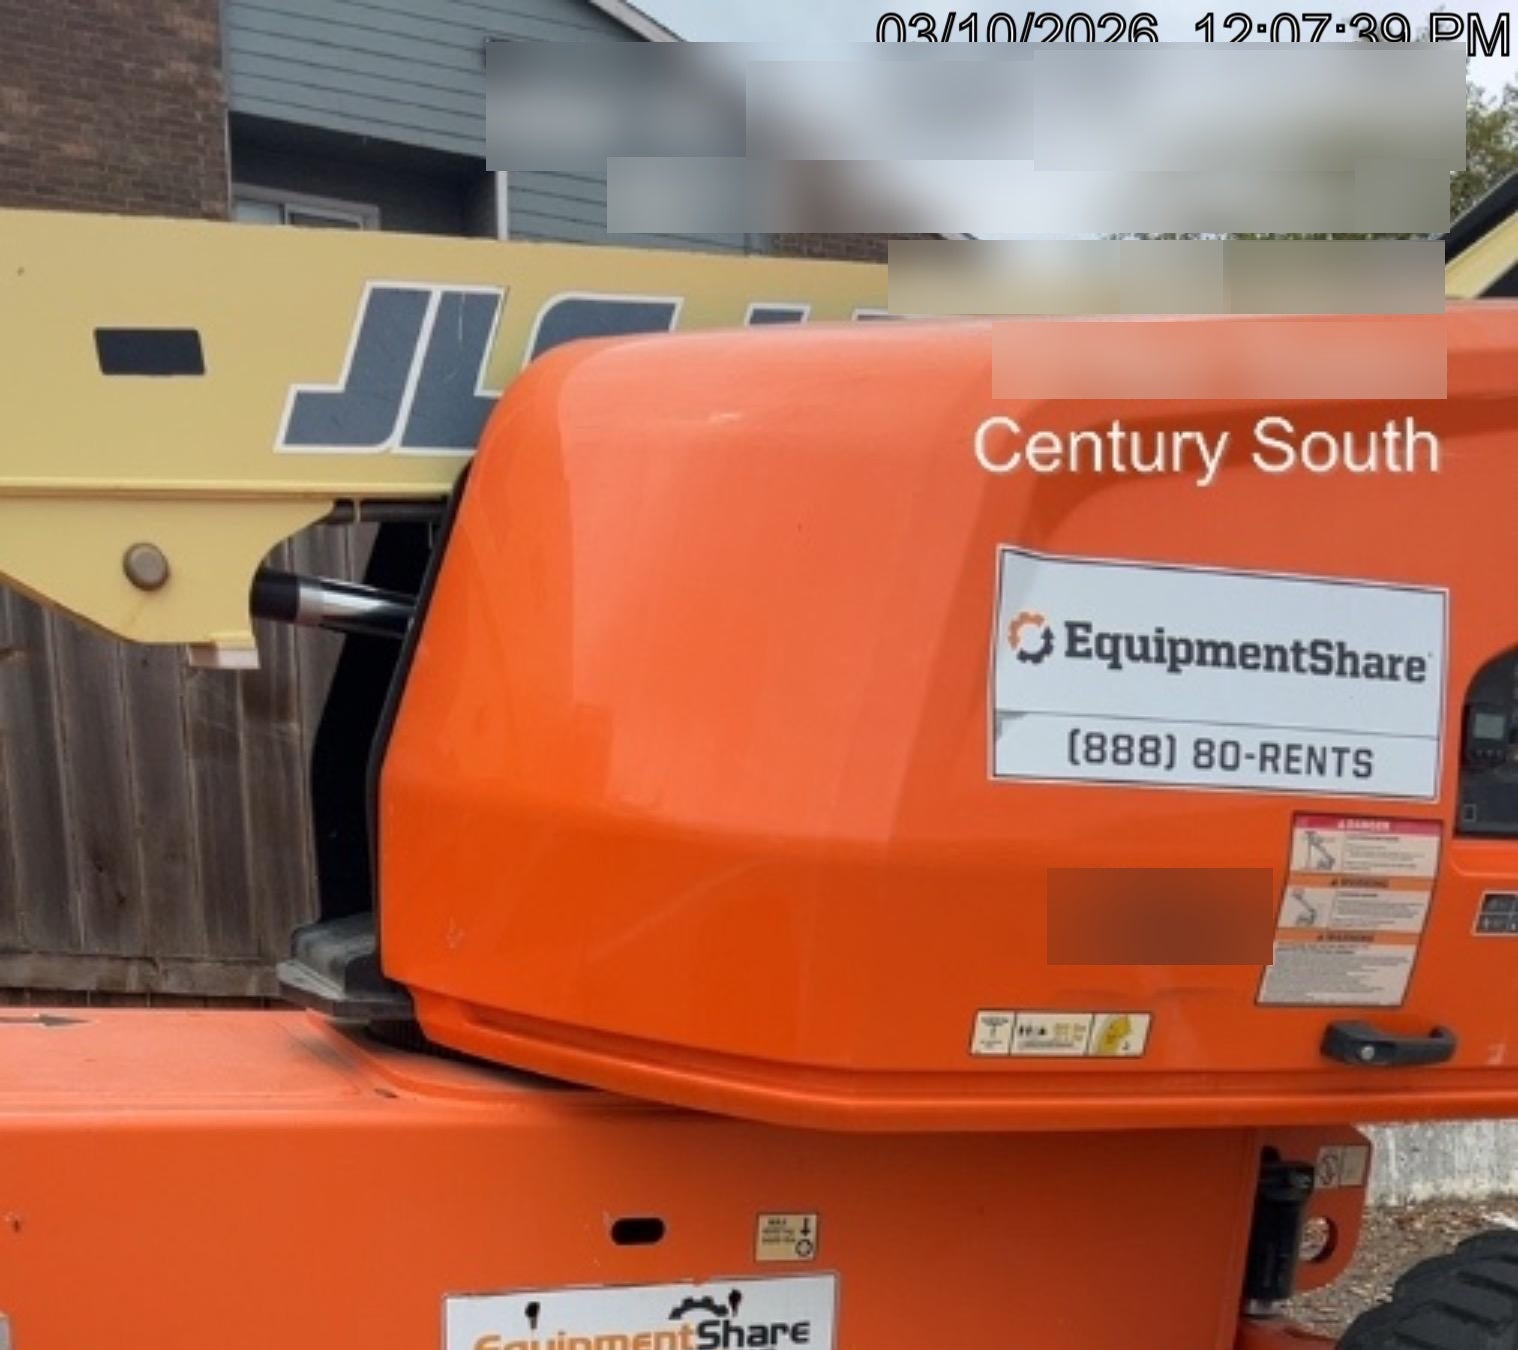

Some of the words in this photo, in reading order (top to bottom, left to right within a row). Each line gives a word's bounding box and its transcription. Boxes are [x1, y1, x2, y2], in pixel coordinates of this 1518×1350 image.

[1063, 620, 1428, 684] EquipmentShare
[1067, 728, 1177, 771] (888)
[1192, 738, 1374, 778] 80-RENTS
